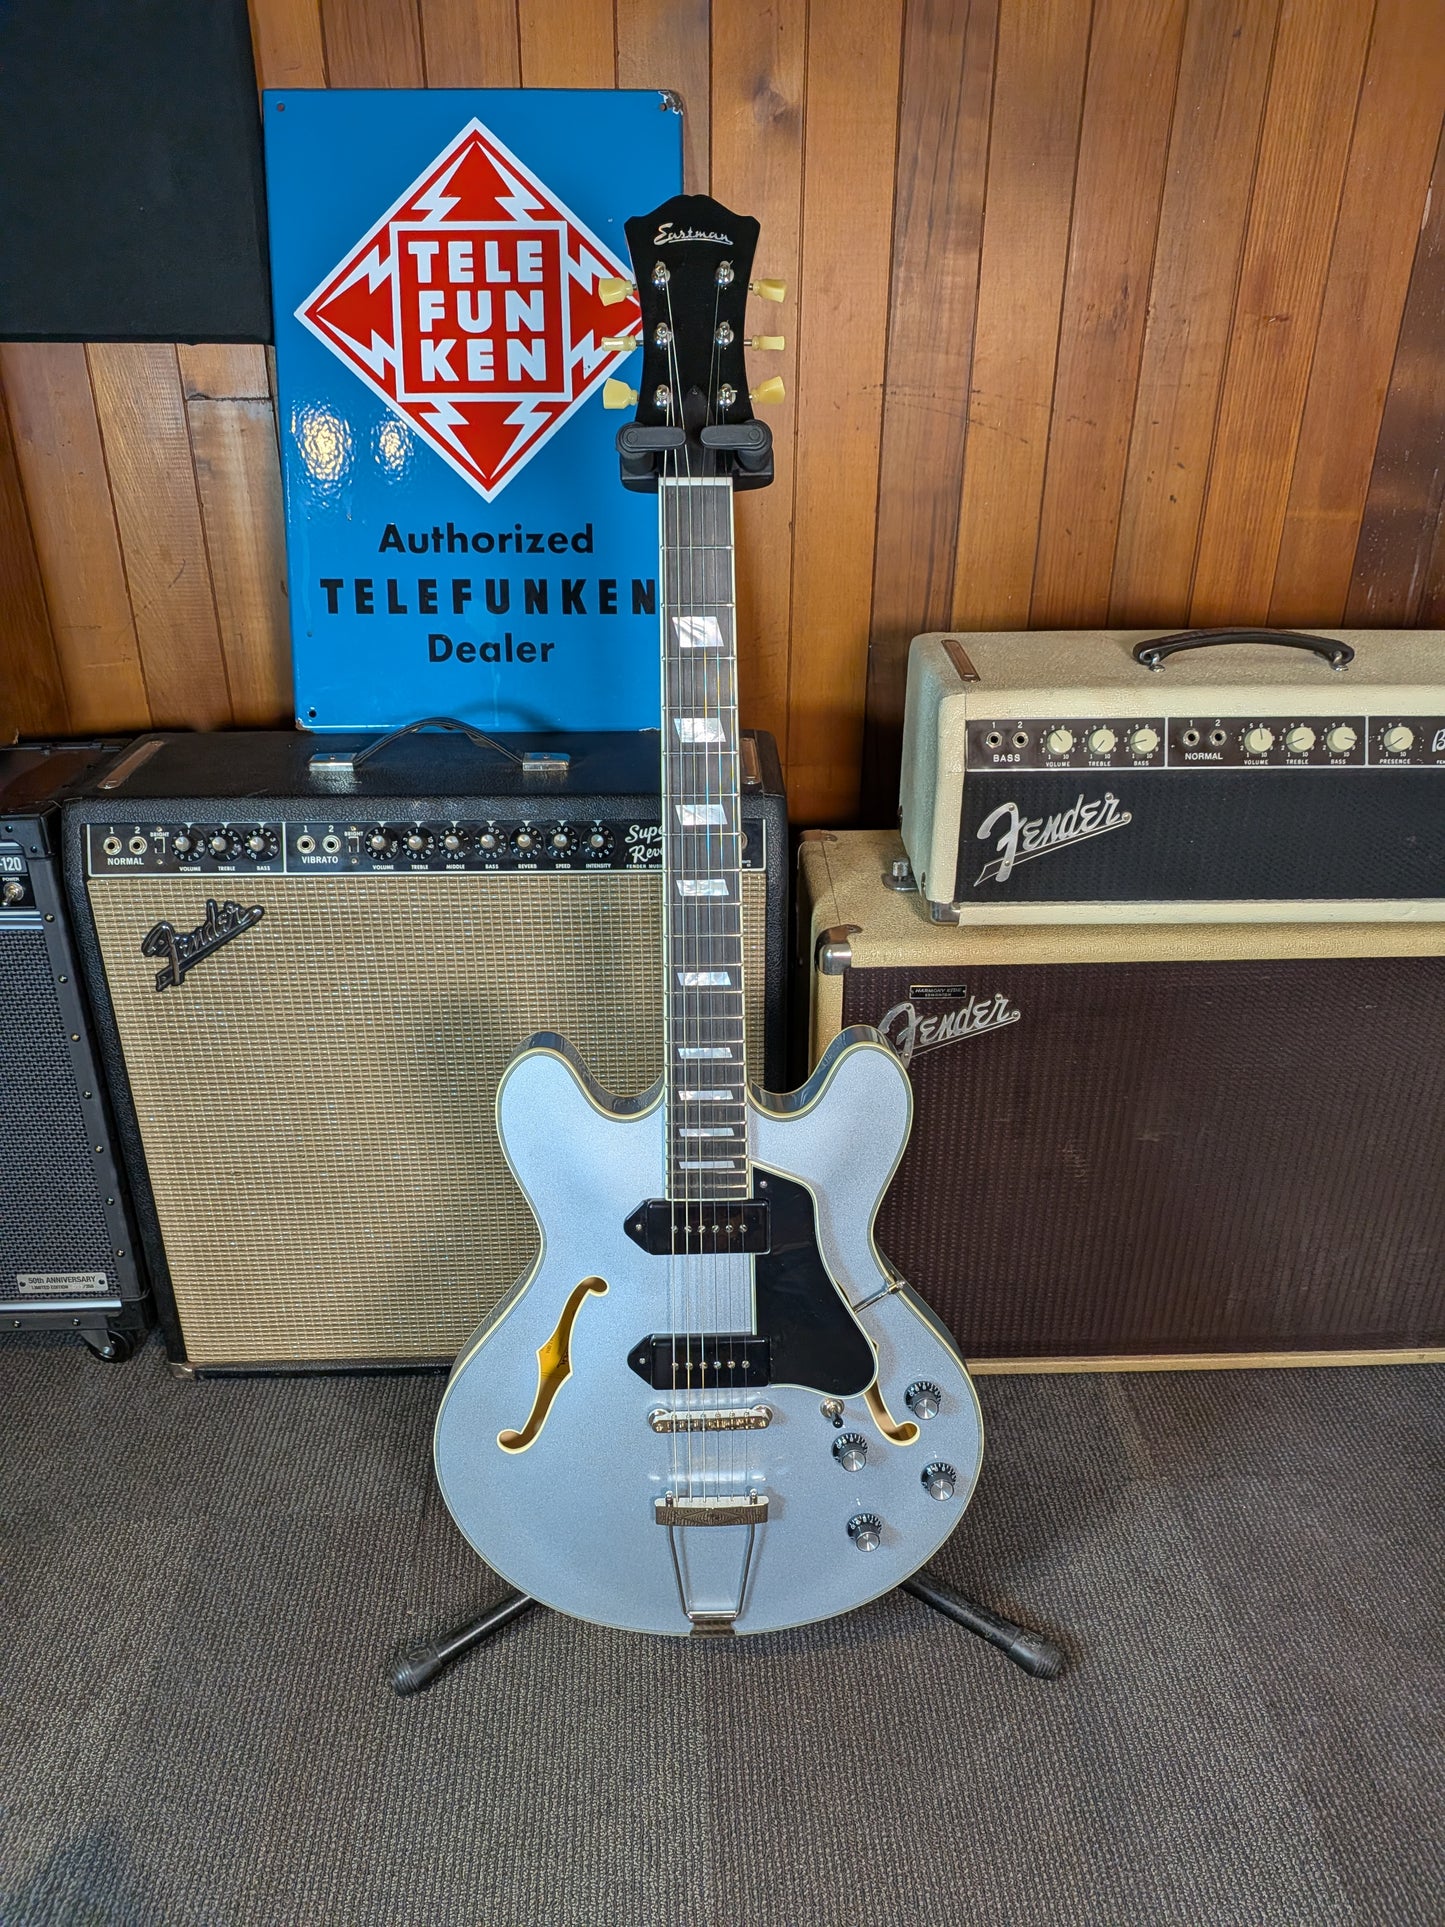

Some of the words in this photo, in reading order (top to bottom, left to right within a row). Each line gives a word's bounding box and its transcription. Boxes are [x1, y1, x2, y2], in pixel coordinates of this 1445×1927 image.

[653, 222, 734, 246] Eastman
[408, 241, 543, 284] TELE
[419, 290, 545, 334] FUN
[421, 339, 547, 382] KEN
[380, 523, 594, 554] Authorized
[320, 578, 656, 615] TELEFUNKEN
[429, 633, 555, 663] Dealer
[992, 721, 996, 729] 1
[1017, 721, 1023, 729] 2
[1189, 719, 1194, 727] 1
[1215, 719, 1221, 727] 2
[992, 754, 1021, 763] BASS
[1184, 752, 1224, 761] NORMAL
[973, 791, 1132, 887] Fender
[107, 857, 144, 866] NORMAL
[301, 856, 339, 864] VIBRATO
[141, 898, 265, 992] Fender
[877, 993, 1021, 1069] Fender
[46, 1275, 96, 1284] ANNIVERSARY
